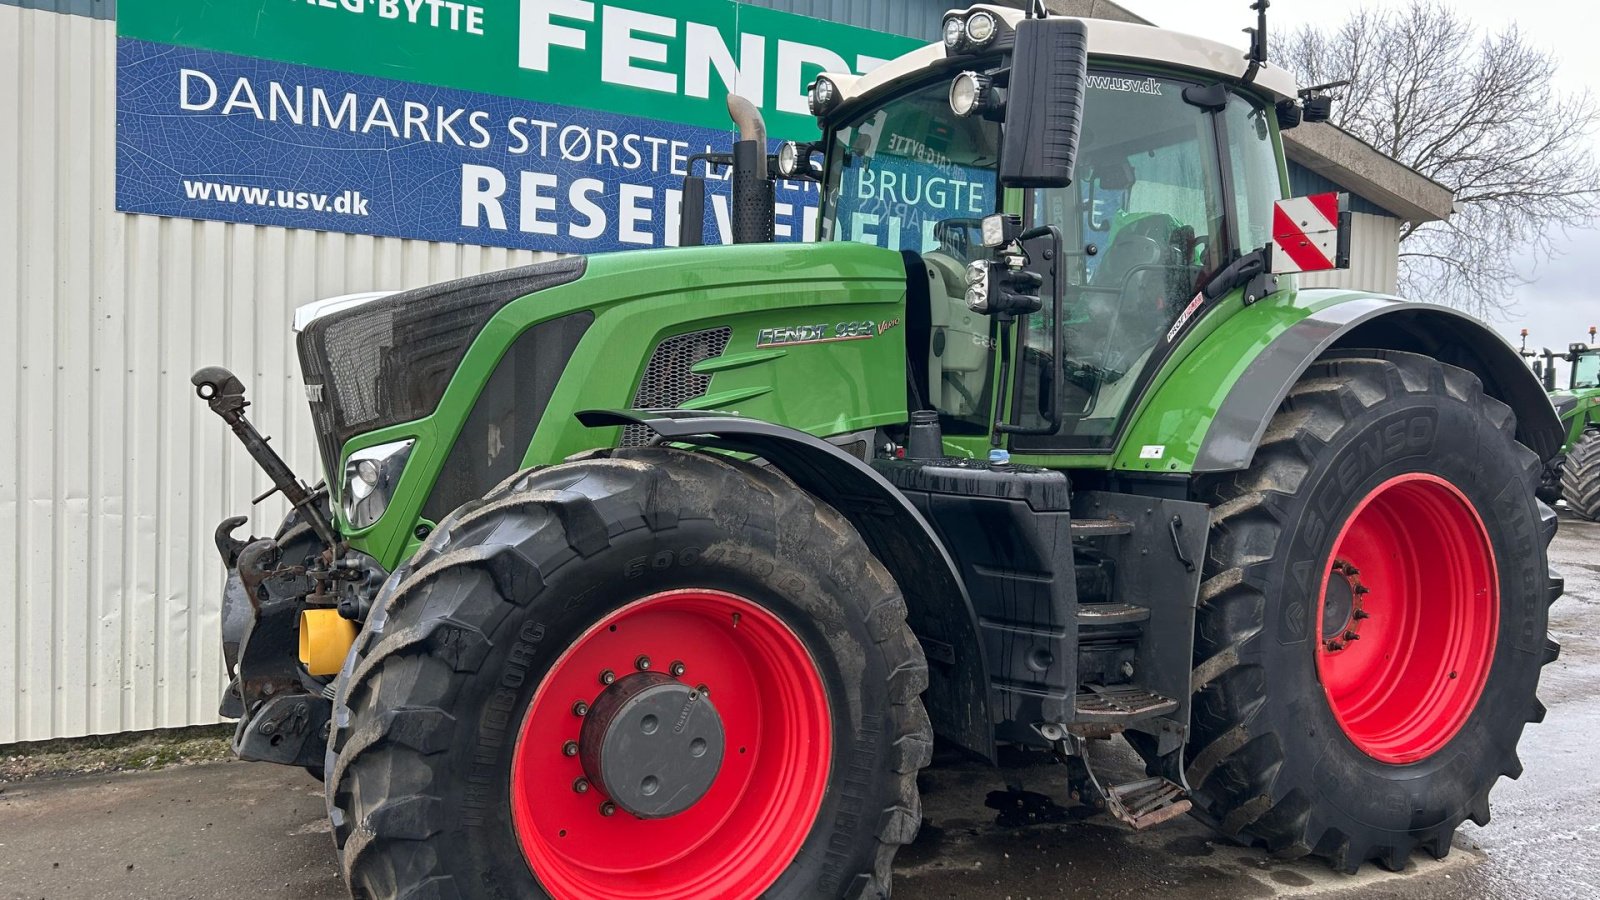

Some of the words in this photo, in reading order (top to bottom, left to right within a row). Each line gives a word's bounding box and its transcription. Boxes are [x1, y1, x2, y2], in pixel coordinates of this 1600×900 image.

[518, 0, 891, 117] FEND
[1085, 75, 1162, 96] w.usv.dk
[179, 68, 491, 149] DANMARKS
[507, 117, 689, 177] STØRSTE
[857, 166, 984, 213] BRUGTE
[184, 180, 369, 217] www.usv.dk
[757, 323, 829, 346] FENDT
[1290, 414, 1437, 598] ASCENSO
